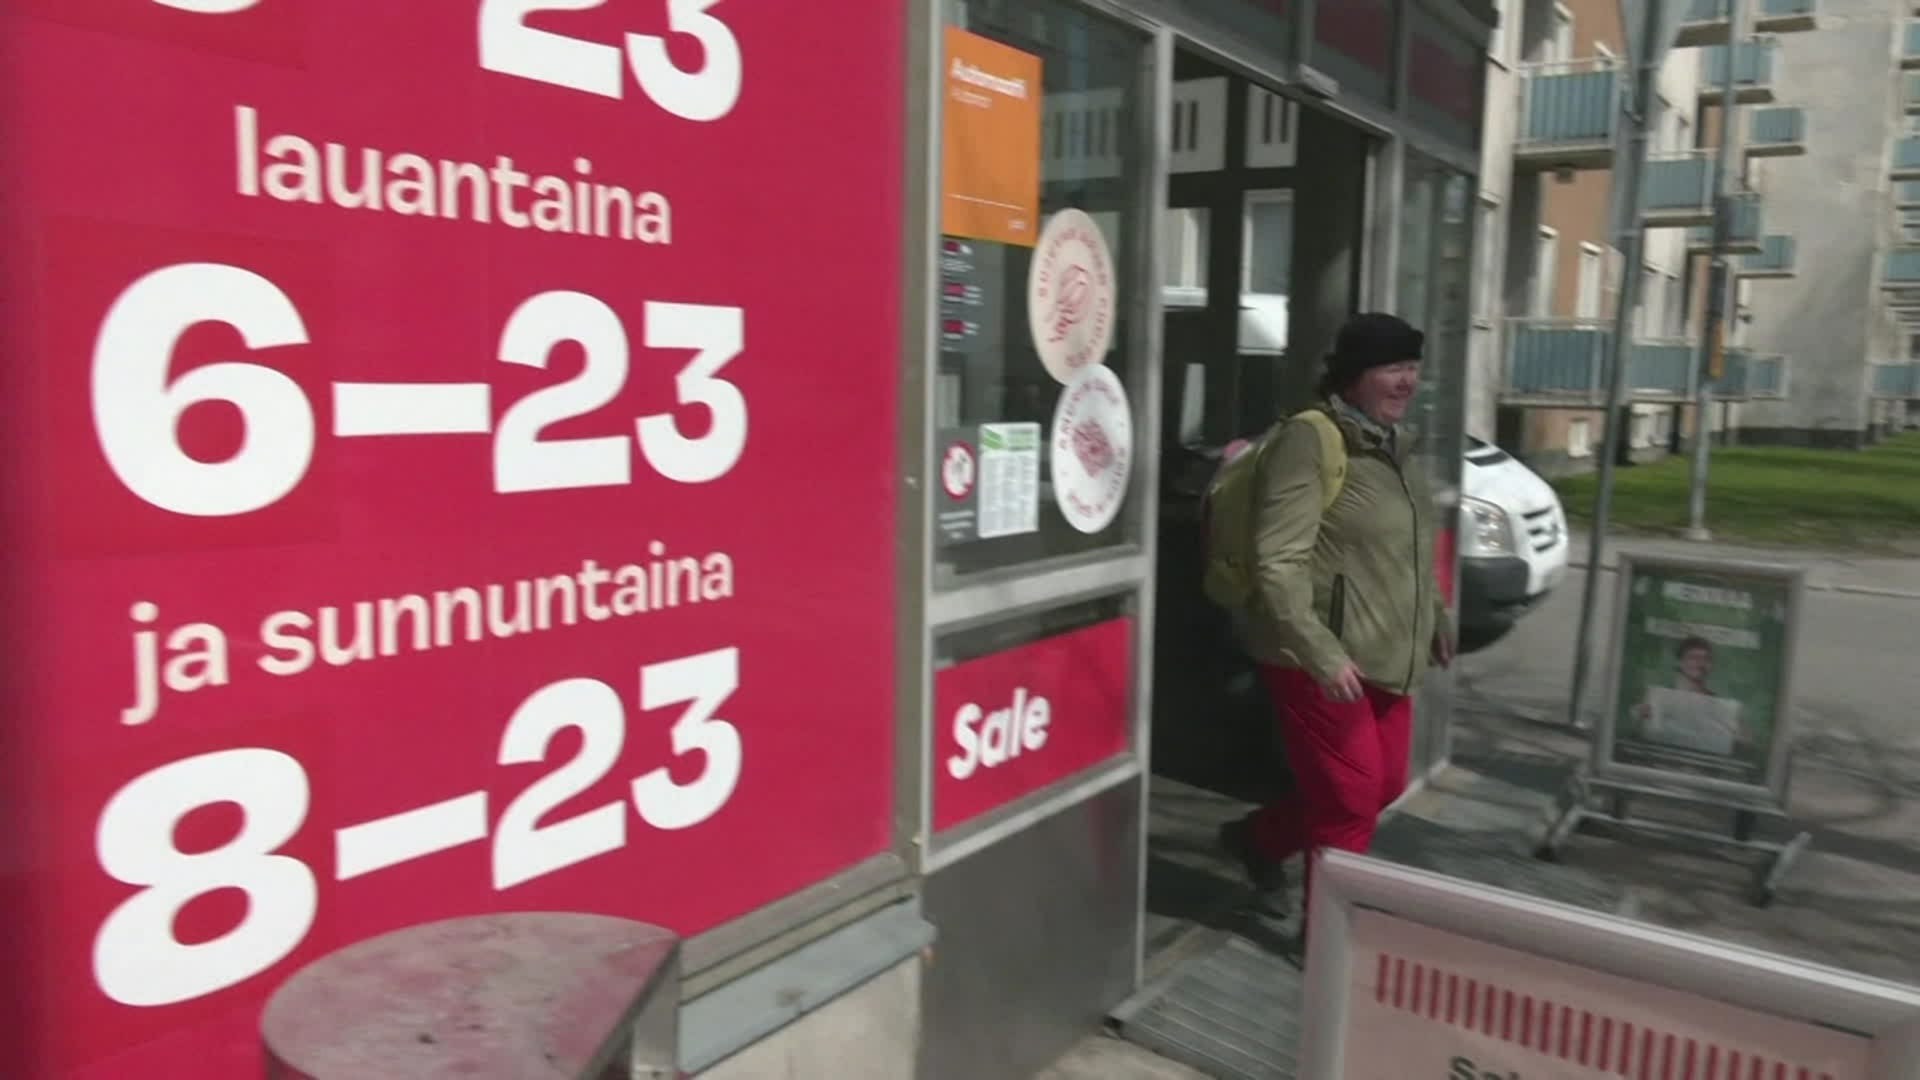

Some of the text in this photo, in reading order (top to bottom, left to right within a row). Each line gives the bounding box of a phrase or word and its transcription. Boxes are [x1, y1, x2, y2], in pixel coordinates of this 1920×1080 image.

[235, 105, 672, 244] lauantaina
[121, 541, 734, 726] ja sunnuntaina
[947, 687, 1050, 779] Sale
